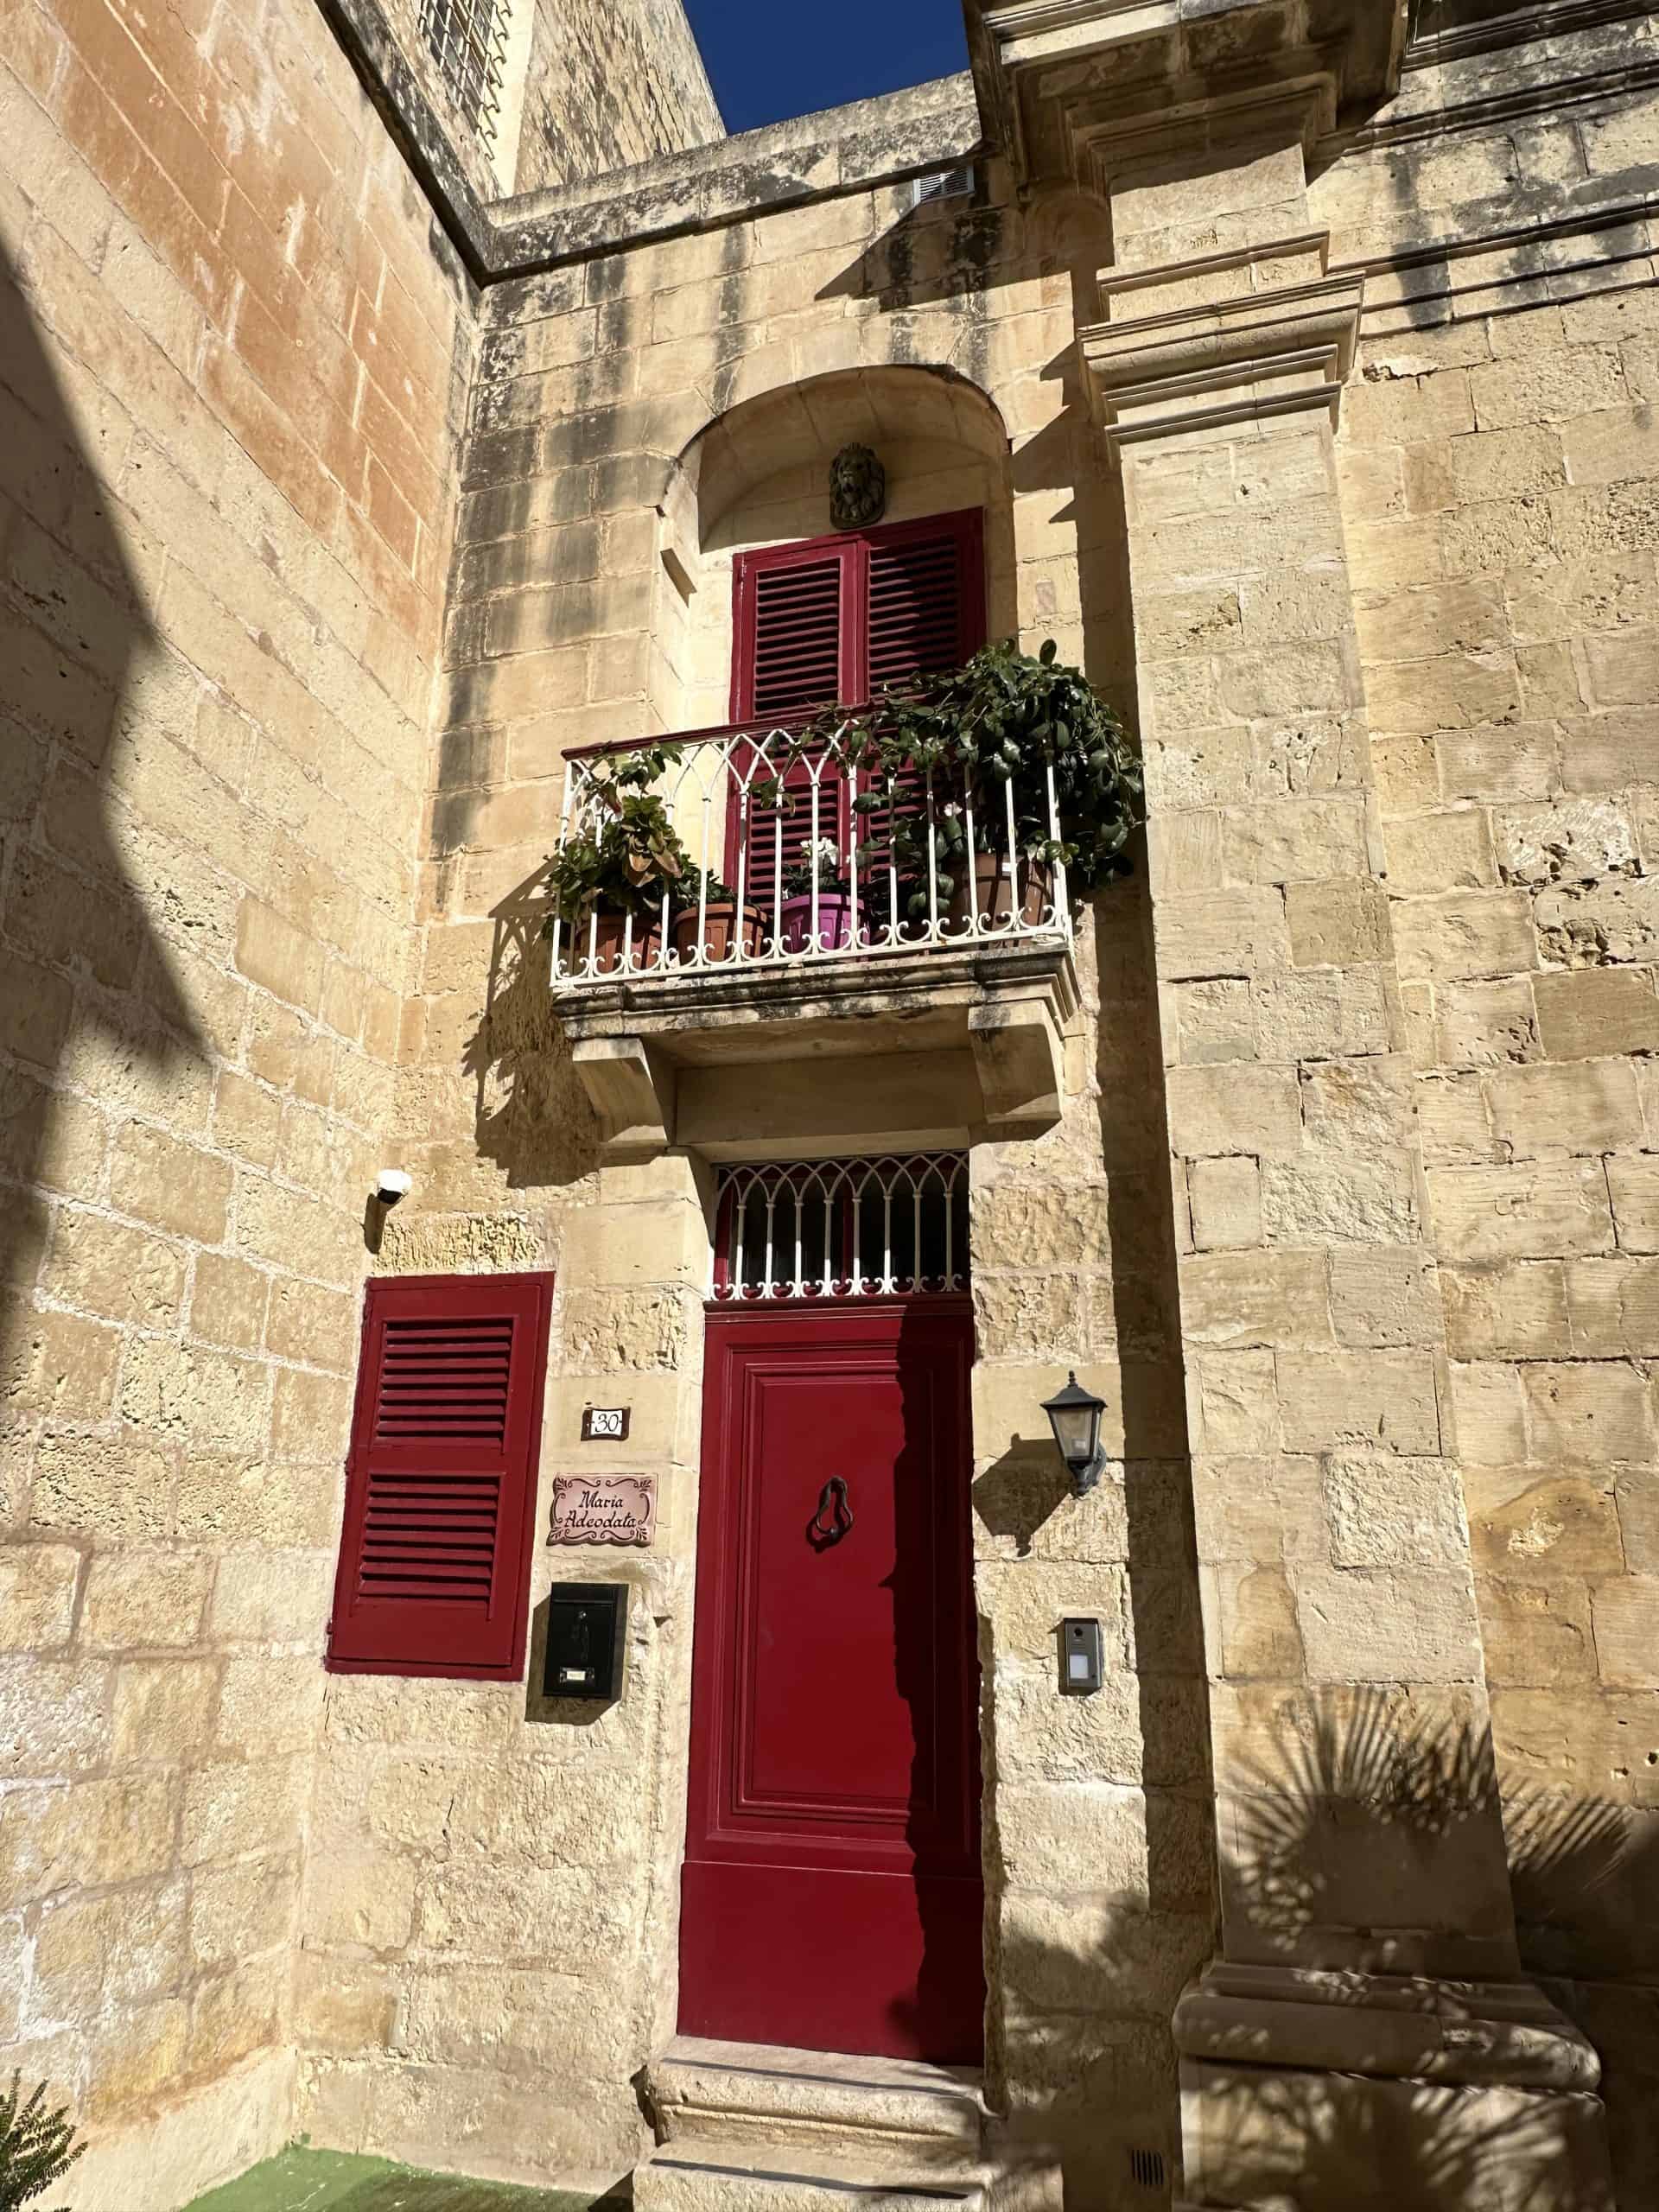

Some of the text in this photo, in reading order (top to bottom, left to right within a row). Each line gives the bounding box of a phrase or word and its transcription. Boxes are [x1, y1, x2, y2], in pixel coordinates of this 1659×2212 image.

[594, 1413, 620, 1433] 30
[578, 1490, 624, 1509] Maria
[564, 1510, 637, 1529] Adeodata
